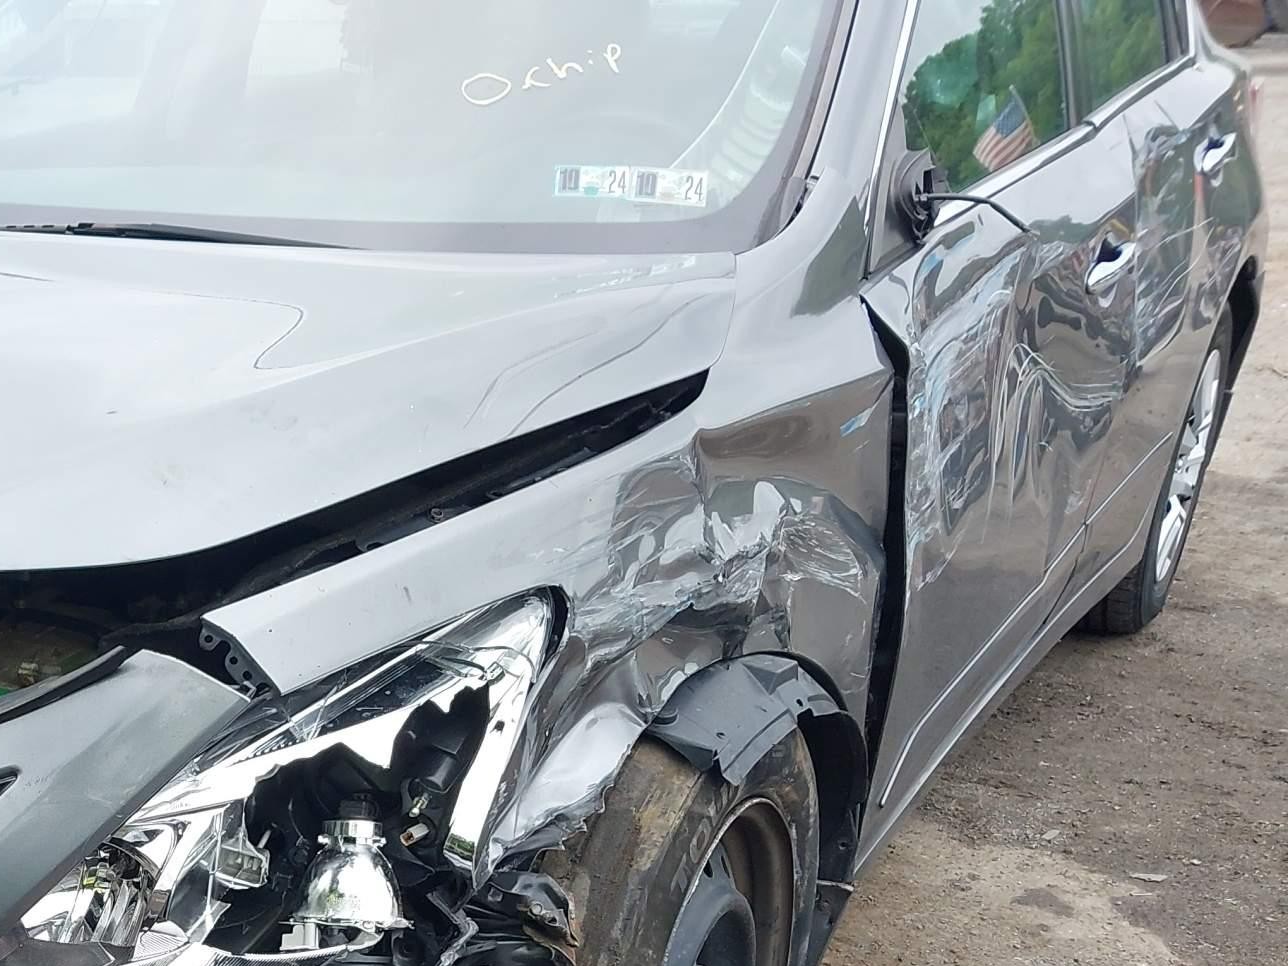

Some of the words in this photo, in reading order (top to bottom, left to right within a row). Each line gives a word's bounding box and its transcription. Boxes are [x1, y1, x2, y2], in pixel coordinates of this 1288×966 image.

[559, 167, 580, 191] 10
[608, 170, 626, 194] 24
[636, 171, 658, 196] 10
[684, 175, 704, 202] 24
